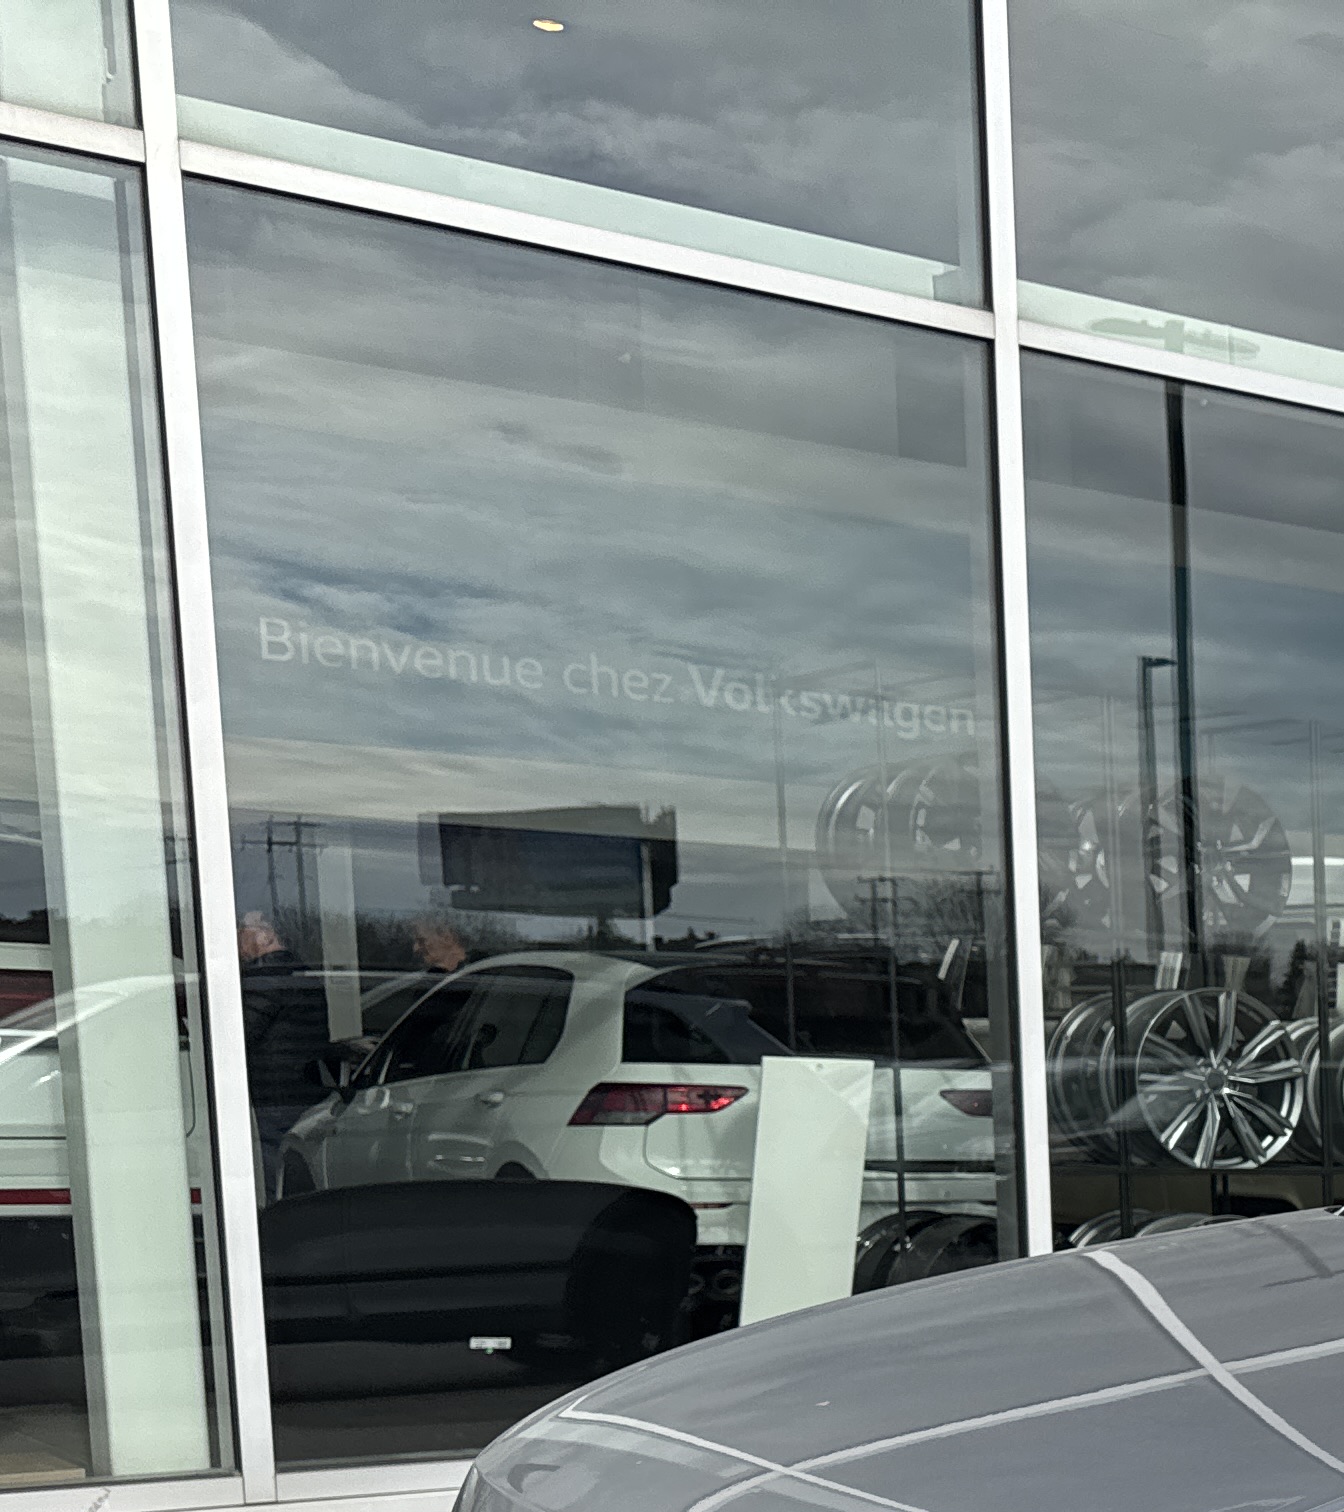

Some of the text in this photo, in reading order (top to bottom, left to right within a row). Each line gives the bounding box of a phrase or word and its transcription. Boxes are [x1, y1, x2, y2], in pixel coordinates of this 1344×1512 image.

[258, 615, 976, 740] Bienvenue chez Volkswagen
